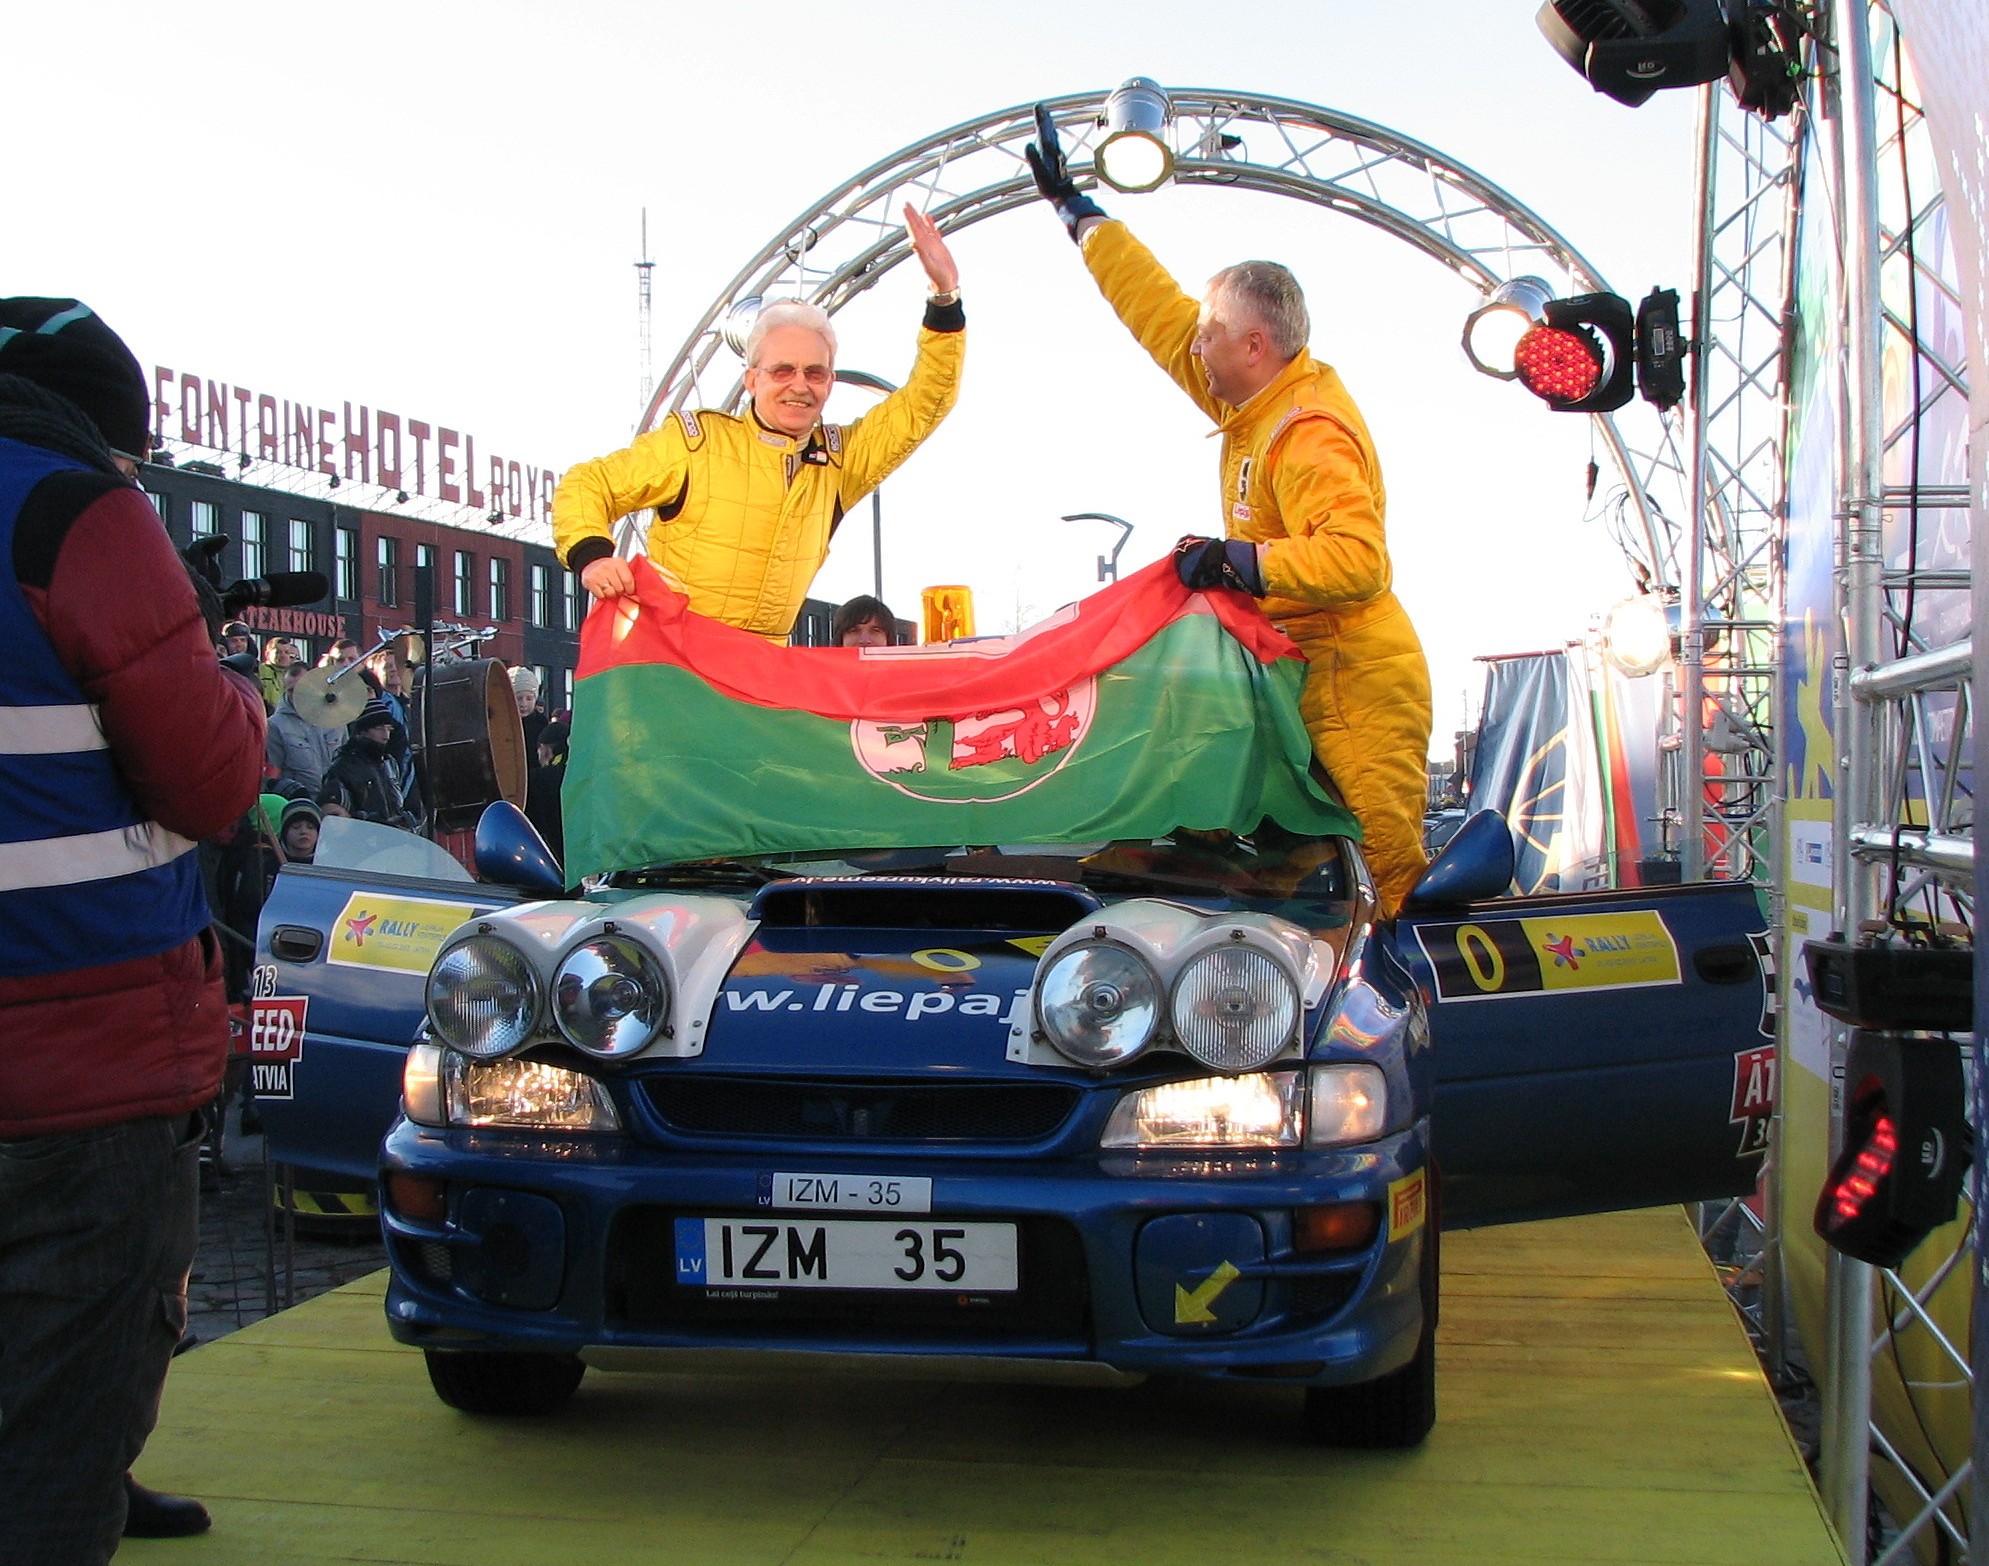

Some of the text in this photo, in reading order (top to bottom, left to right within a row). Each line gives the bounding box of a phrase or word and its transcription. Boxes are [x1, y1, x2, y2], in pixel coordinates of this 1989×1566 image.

[155, 365, 562, 523] FONTAINE HOTEL ROYA
[380, 919, 420, 937] RALLY
[1456, 924, 1505, 992] 0
[717, 983, 1031, 1024] w.liepaj
[252, 1009, 296, 1051] EED
[758, 1196, 771, 1205] LV
[788, 1178, 839, 1204] IZM
[868, 1181, 901, 1206] 35
[679, 1259, 702, 1273] LV
[722, 1225, 966, 1282] IZM 35
